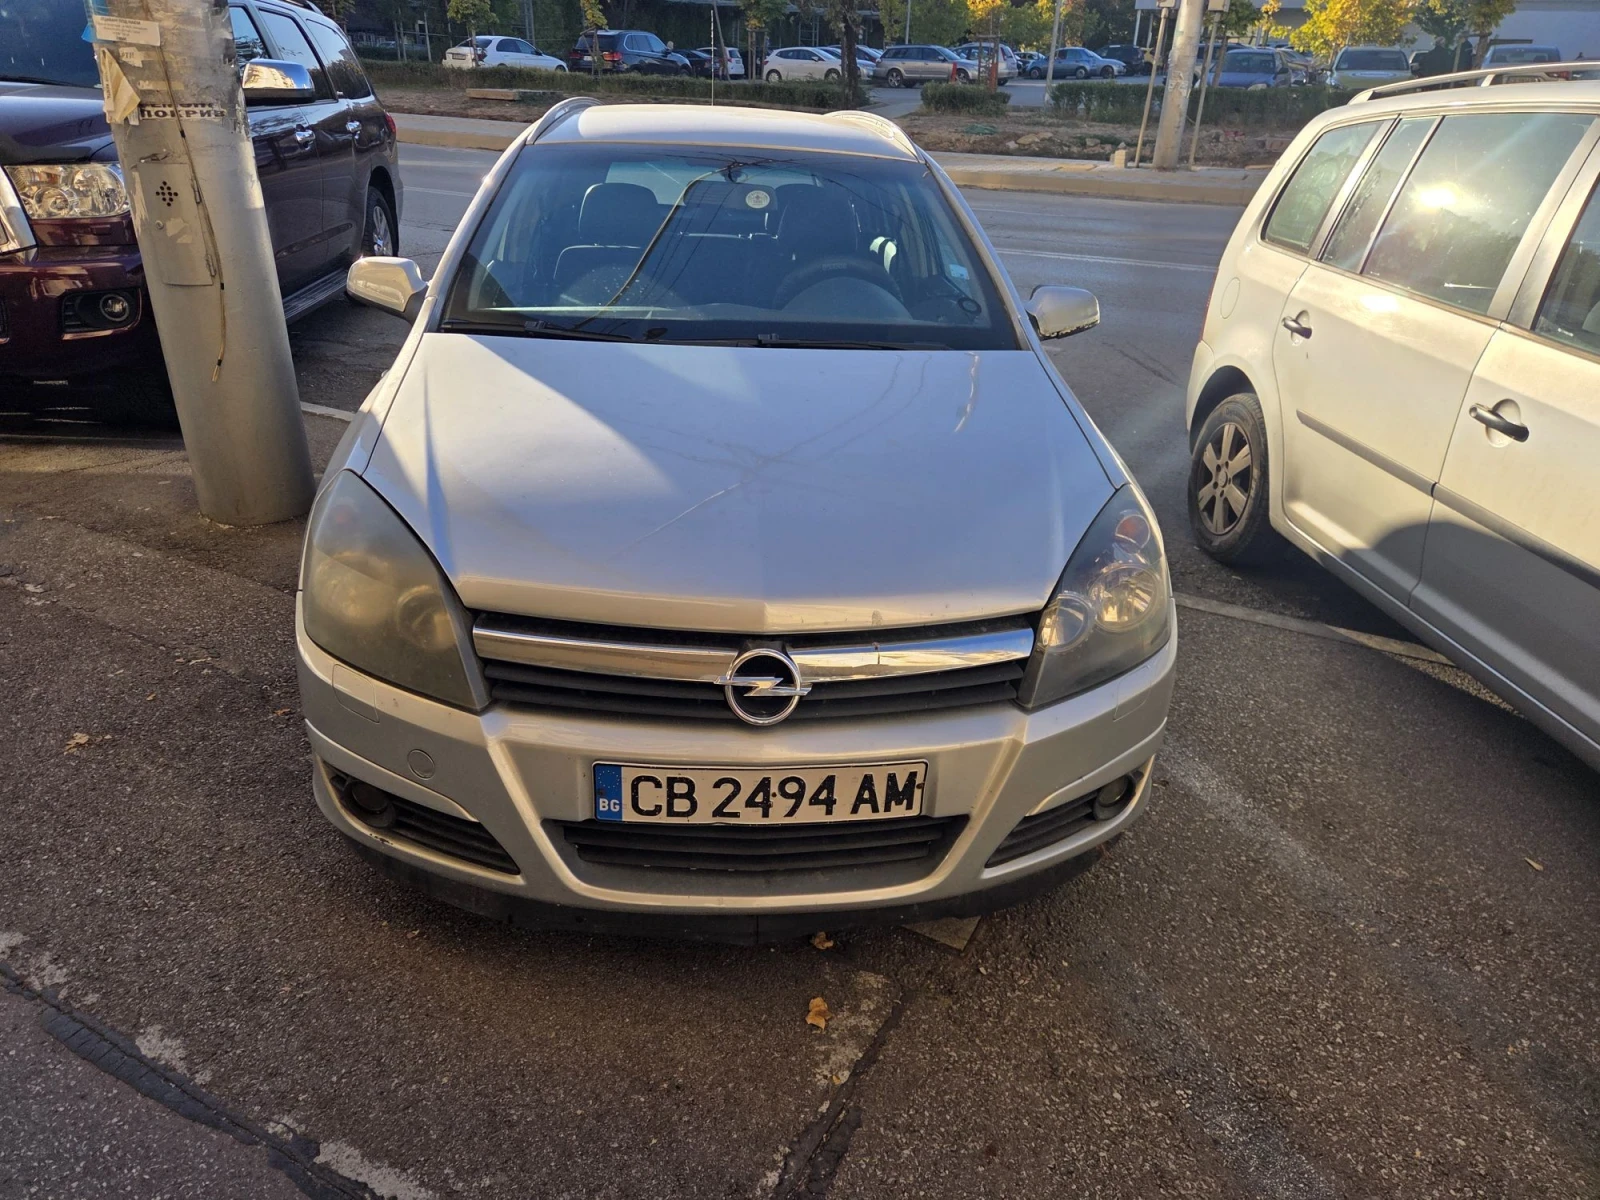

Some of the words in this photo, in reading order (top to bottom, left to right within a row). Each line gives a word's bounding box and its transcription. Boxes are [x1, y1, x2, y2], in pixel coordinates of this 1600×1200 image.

[599, 798, 620, 811] BG
[630, 775, 698, 818] CB
[711, 775, 837, 819] 2494
[850, 770, 918, 815] AM
